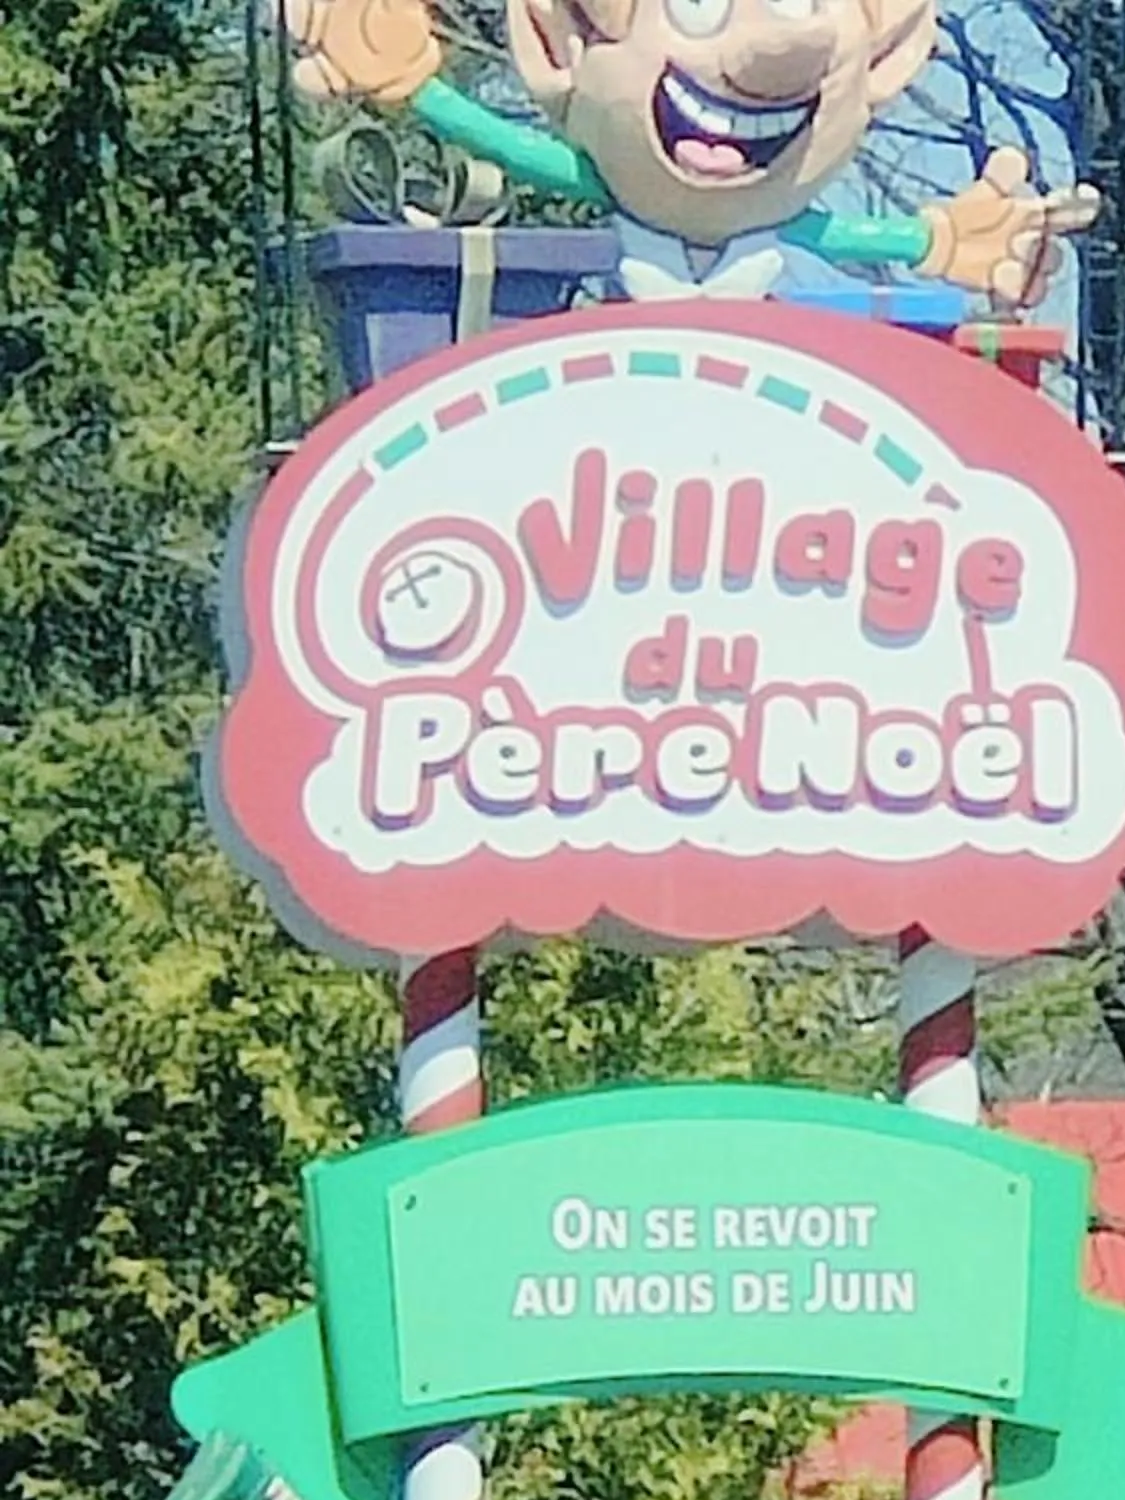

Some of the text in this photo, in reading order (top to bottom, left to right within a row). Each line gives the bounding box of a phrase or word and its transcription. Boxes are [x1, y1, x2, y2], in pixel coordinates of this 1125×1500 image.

[516, 447, 1025, 648] Village
[622, 614, 760, 702] du
[362, 690, 1078, 828] Père Noël
